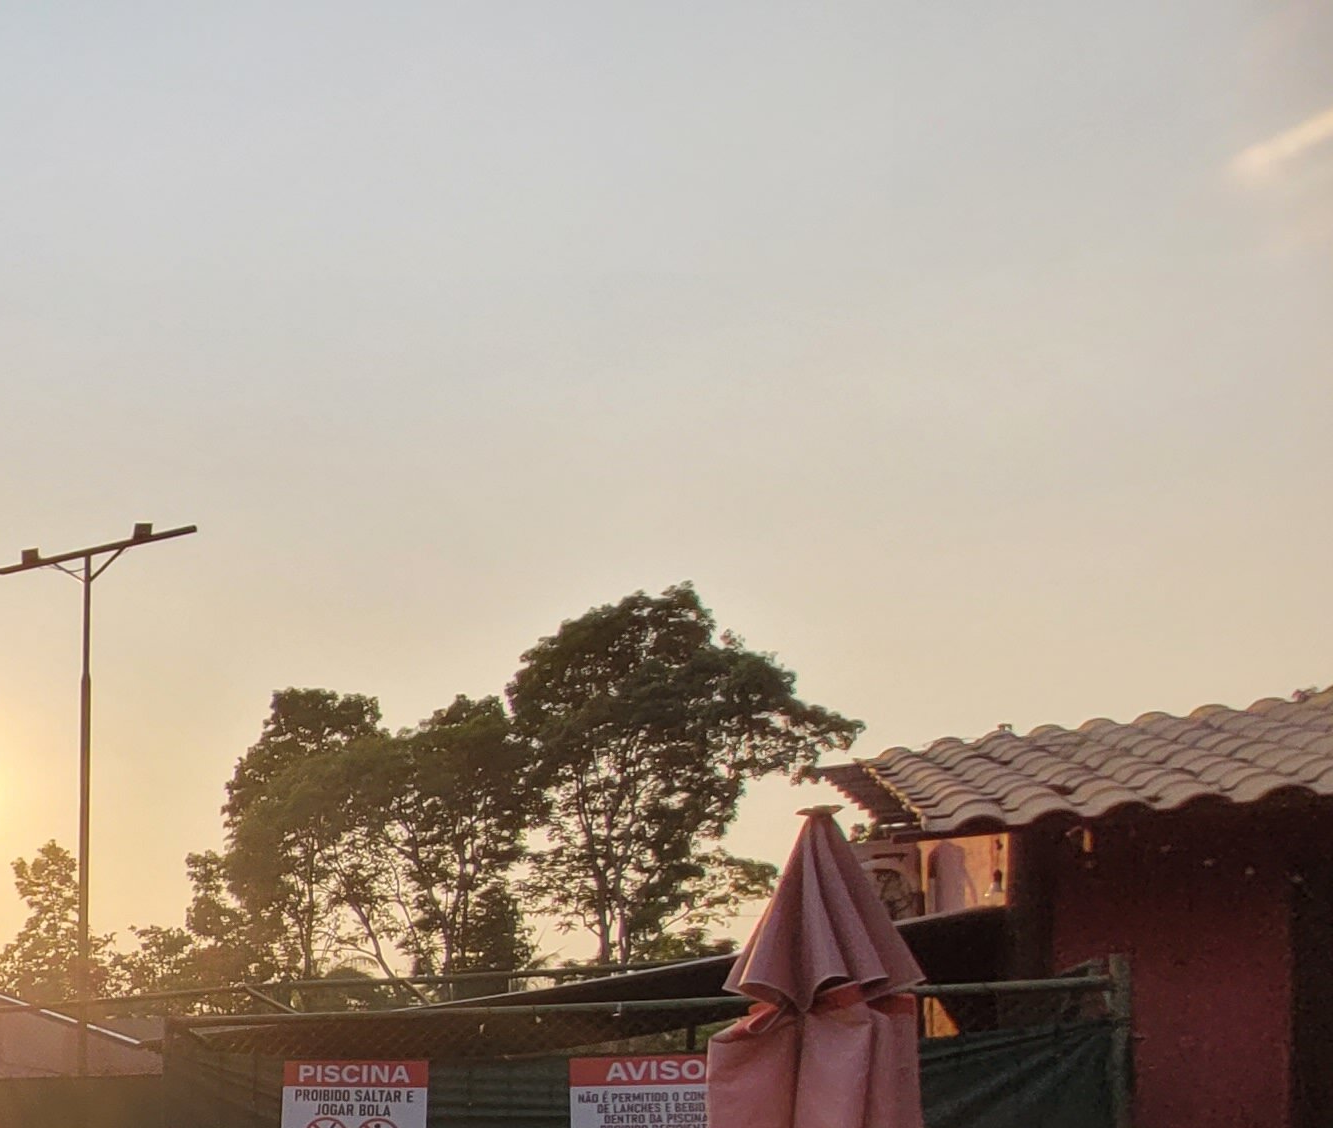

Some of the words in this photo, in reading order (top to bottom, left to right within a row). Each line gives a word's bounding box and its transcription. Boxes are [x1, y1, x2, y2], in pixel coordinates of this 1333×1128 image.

[298, 1065, 410, 1083] PISCINA
[606, 1059, 705, 1082] AVISO
[294, 1089, 350, 1102] PROIBIDO
[354, 1090, 401, 1103] SALTAR
[406, 1091, 414, 1103] E
[578, 1091, 599, 1104] NÃO
[603, 1090, 608, 1103] É
[611, 1092, 669, 1103] PERMITIDO
[672, 1091, 679, 1102] O
[683, 1091, 707, 1102] CON
[315, 1103, 354, 1117] JOGAR
[359, 1104, 391, 1117] BOLA
[597, 1103, 612, 1114] DE
[613, 1103, 661, 1114] LANCHES
[665, 1102, 671, 1113] E
[674, 1102, 707, 1113] BEBID
[604, 1113, 645, 1125] DENTRO
[649, 1113, 663, 1124] DA
